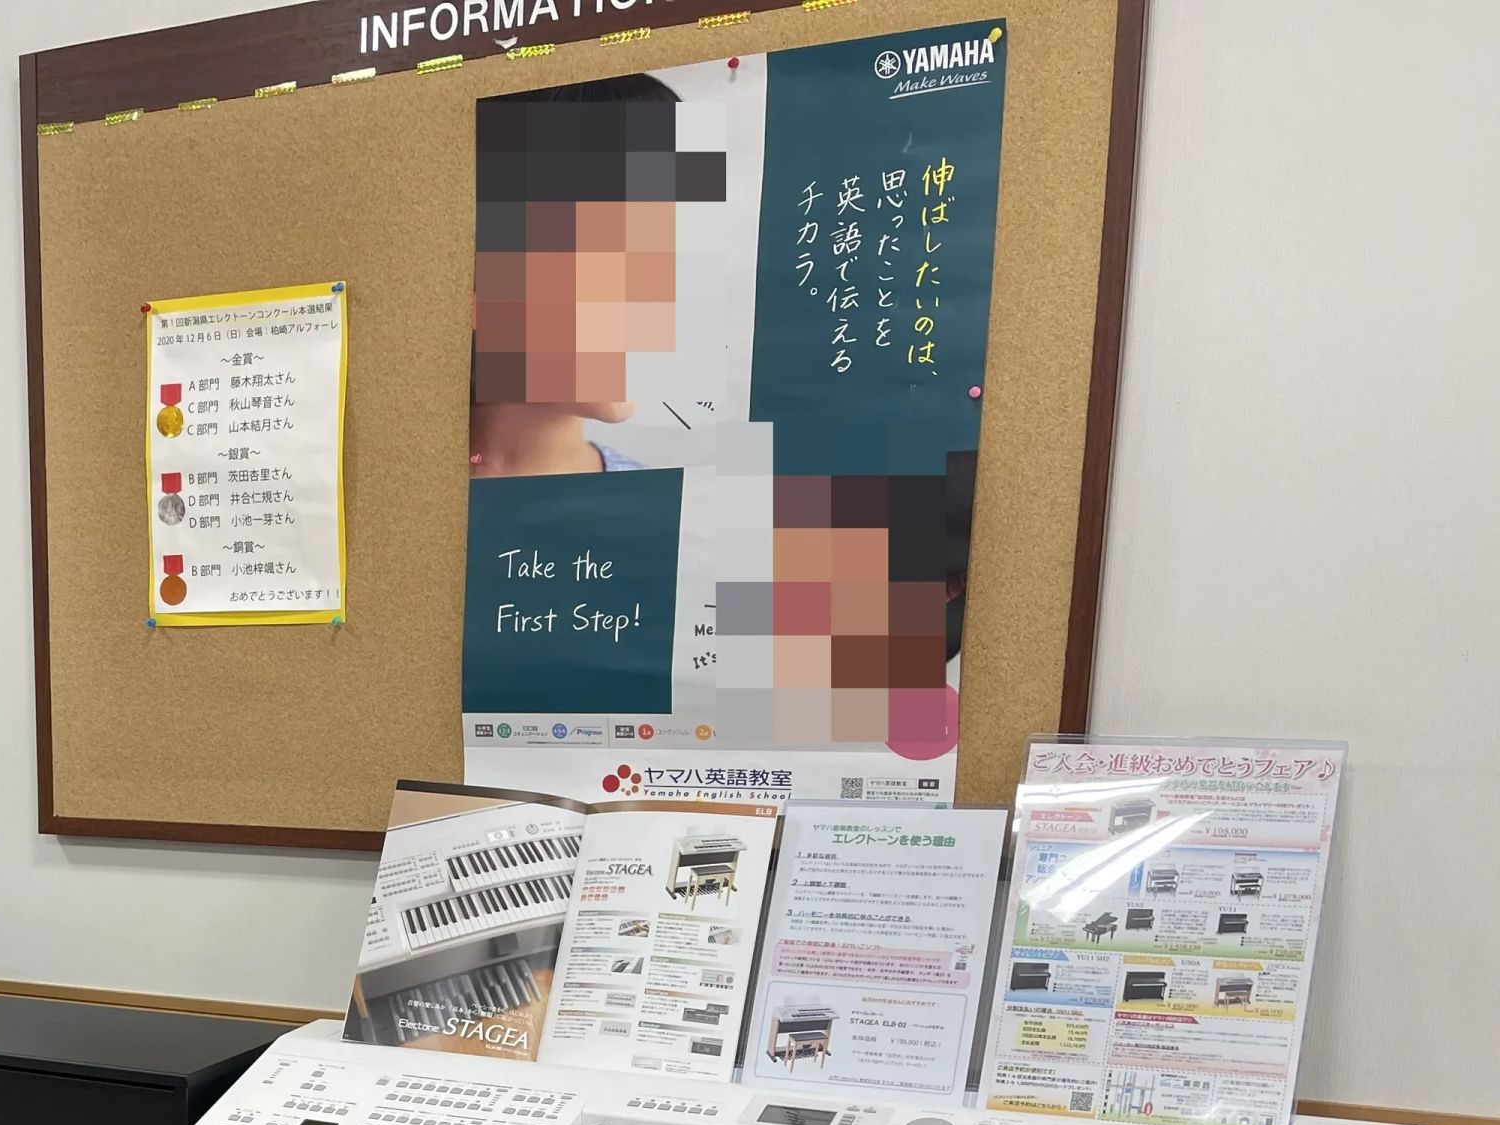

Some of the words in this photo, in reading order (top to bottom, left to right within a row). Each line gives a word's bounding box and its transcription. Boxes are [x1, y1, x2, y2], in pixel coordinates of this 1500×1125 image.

[360, 0, 673, 53] INFORMA
[902, 37, 994, 75] YAMAHA
[893, 77, 937, 94] Make
[940, 70, 988, 86] Waves
[795, 180, 824, 296] チカラ。
[827, 175, 866, 373] 英語で伝える
[875, 170, 907, 347] 思ったことを
[907, 157, 955, 376] 伸ばしたいのは、
[228, 417, 294, 433] 山本結月さん
[497, 549, 556, 581] Take
[572, 551, 614, 581] the
[497, 603, 558, 634] First
[572, 603, 642, 642] Step!
[644, 767, 793, 786] ヤマハ英語教室
[644, 789, 689, 797] Yamaha
[697, 790, 742, 799] English
[750, 791, 791, 800] School
[832, 833, 956, 847] エレクトーンを使う理由
[1035, 823, 1076, 833] STAGEA
[606, 864, 653, 875] STAGEA
[398, 1018, 440, 1033] Electone
[442, 1017, 529, 1050] STAGEA
[850, 1018, 879, 1026] STAGEA
